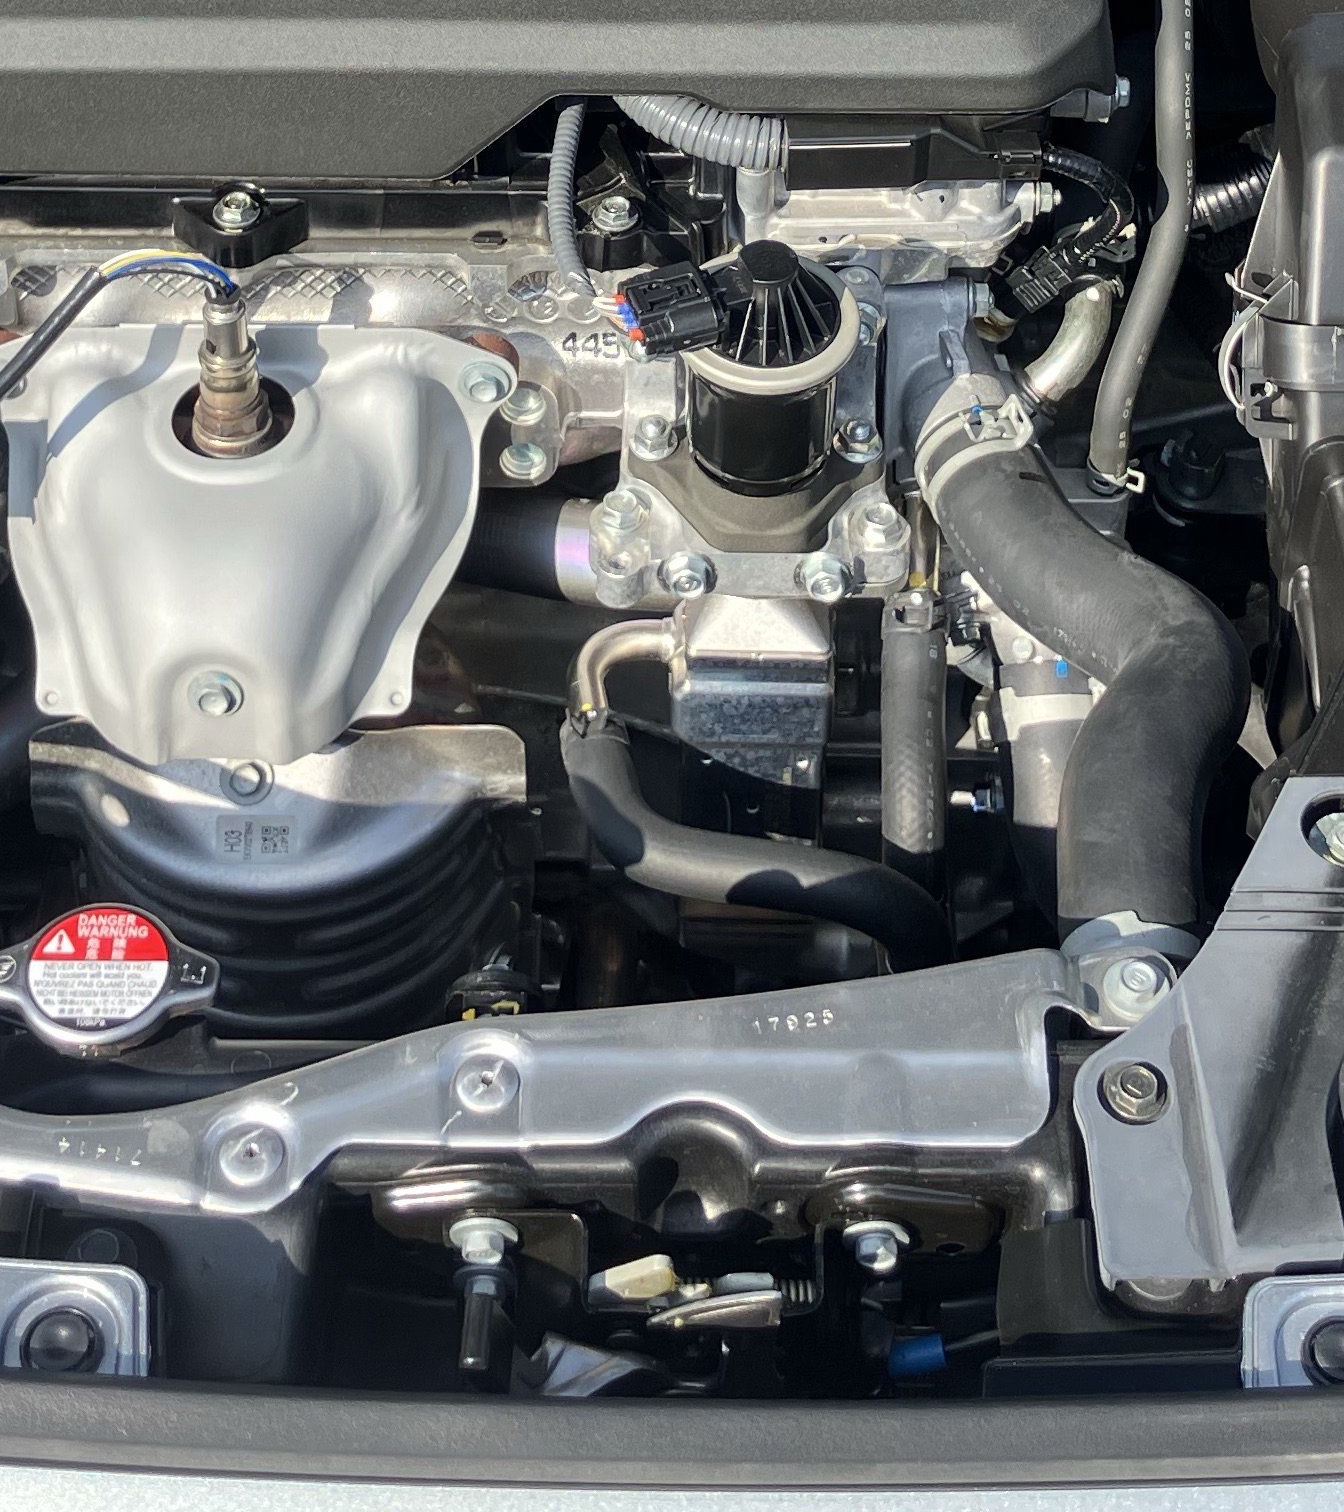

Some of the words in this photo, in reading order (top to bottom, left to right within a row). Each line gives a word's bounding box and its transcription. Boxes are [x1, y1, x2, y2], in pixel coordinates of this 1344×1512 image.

[561, 331, 621, 359] 445
[77, 913, 137, 926] DANGER
[77, 925, 149, 938] WARNUNG
